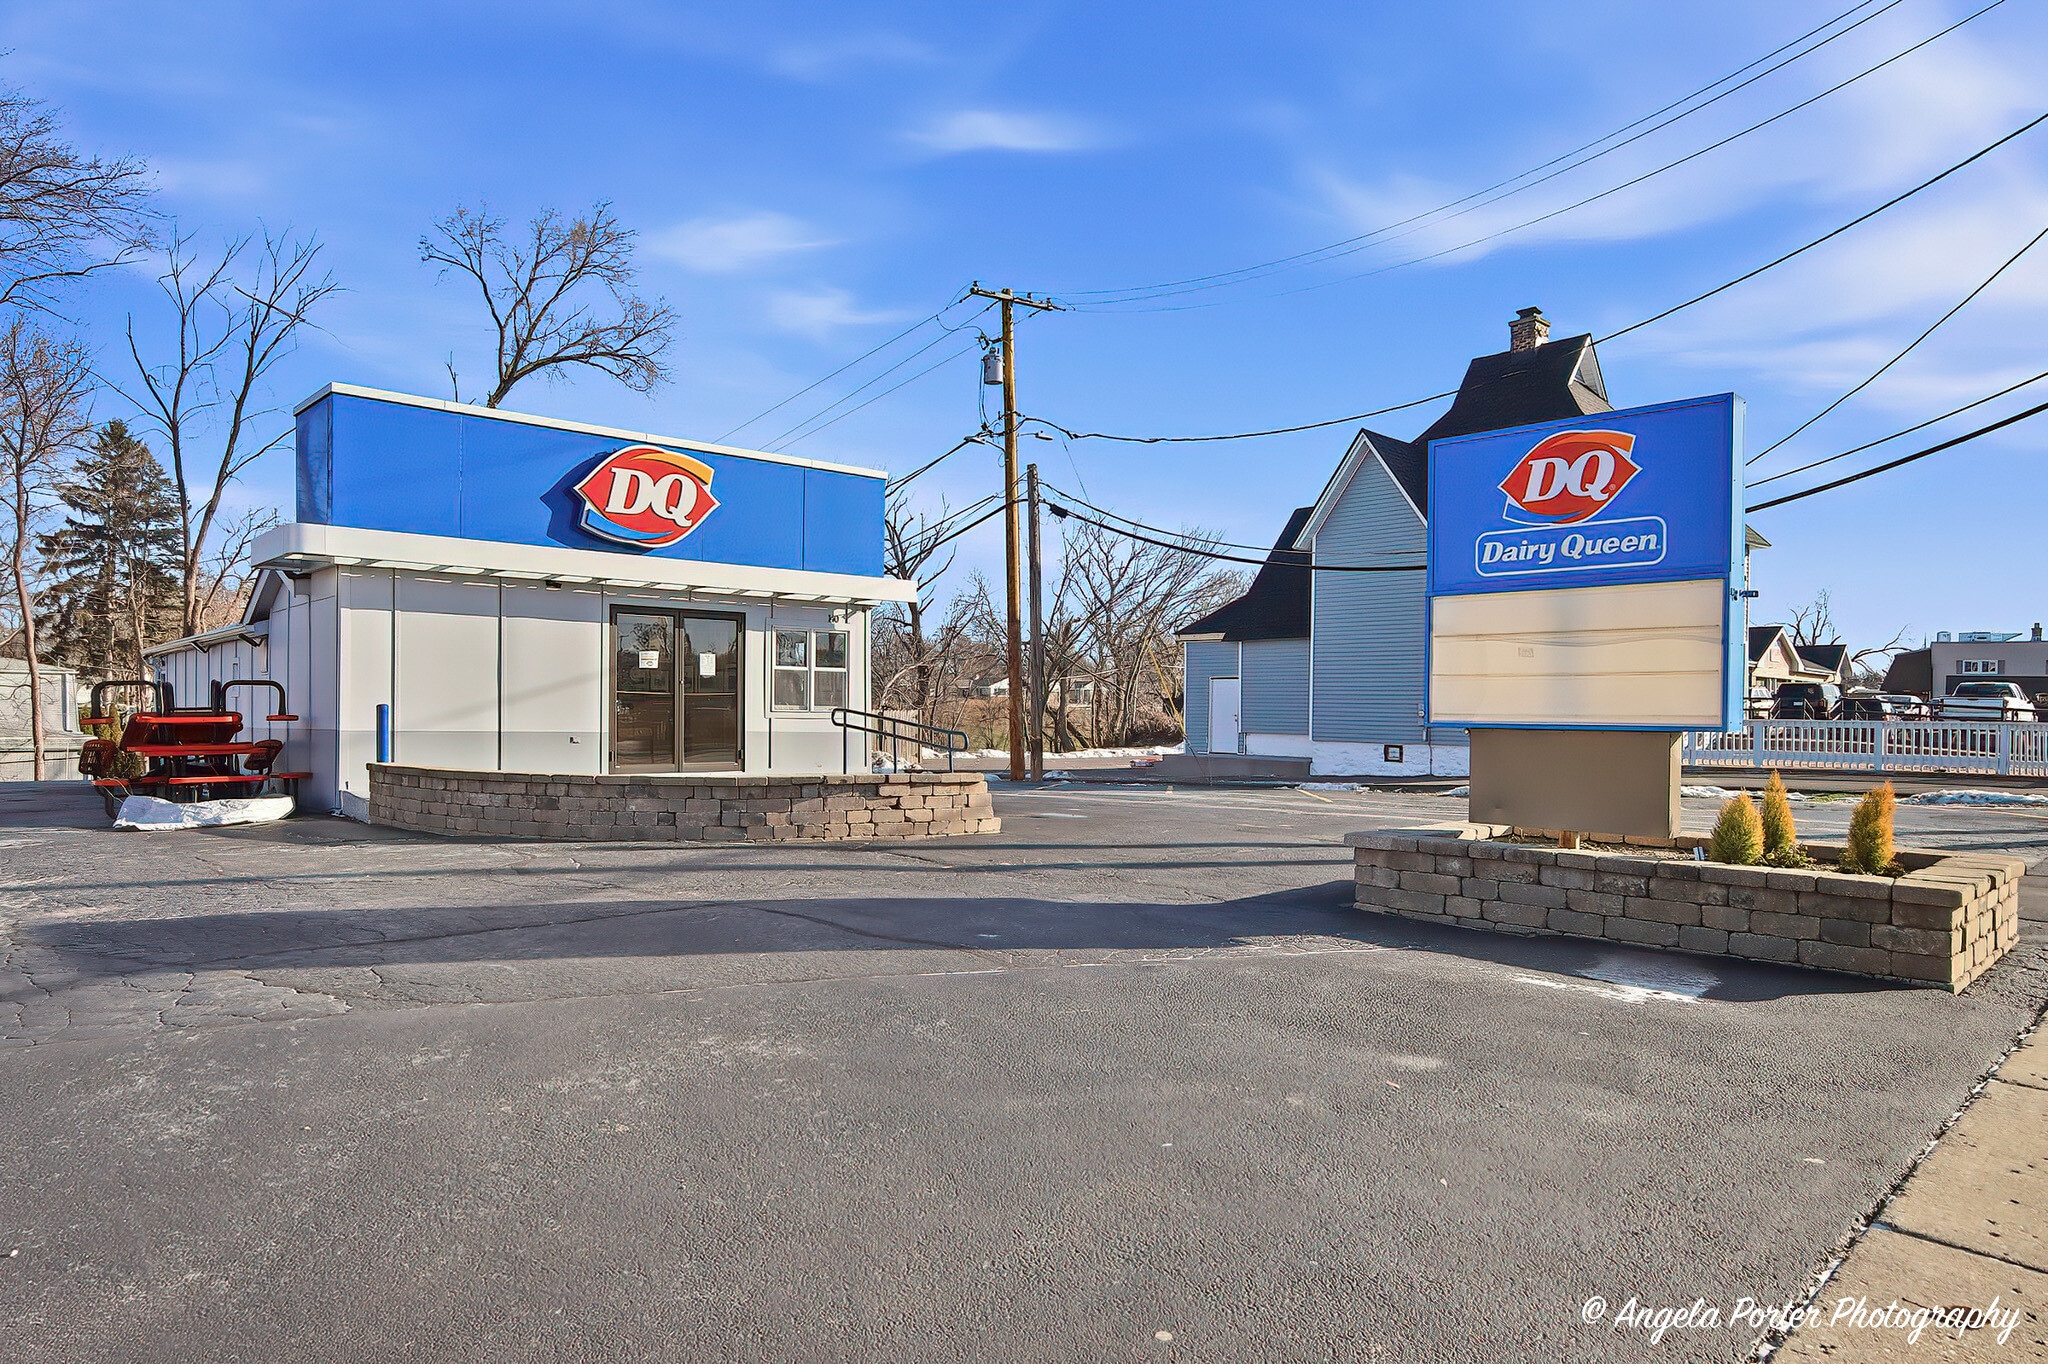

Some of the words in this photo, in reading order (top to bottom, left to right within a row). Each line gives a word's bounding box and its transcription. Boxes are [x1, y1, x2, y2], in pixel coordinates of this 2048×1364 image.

[604, 466, 698, 527] DQ
[1522, 450, 1615, 502] DQ
[1481, 539, 1557, 565] Dairy
[1560, 531, 1657, 560] Queen
